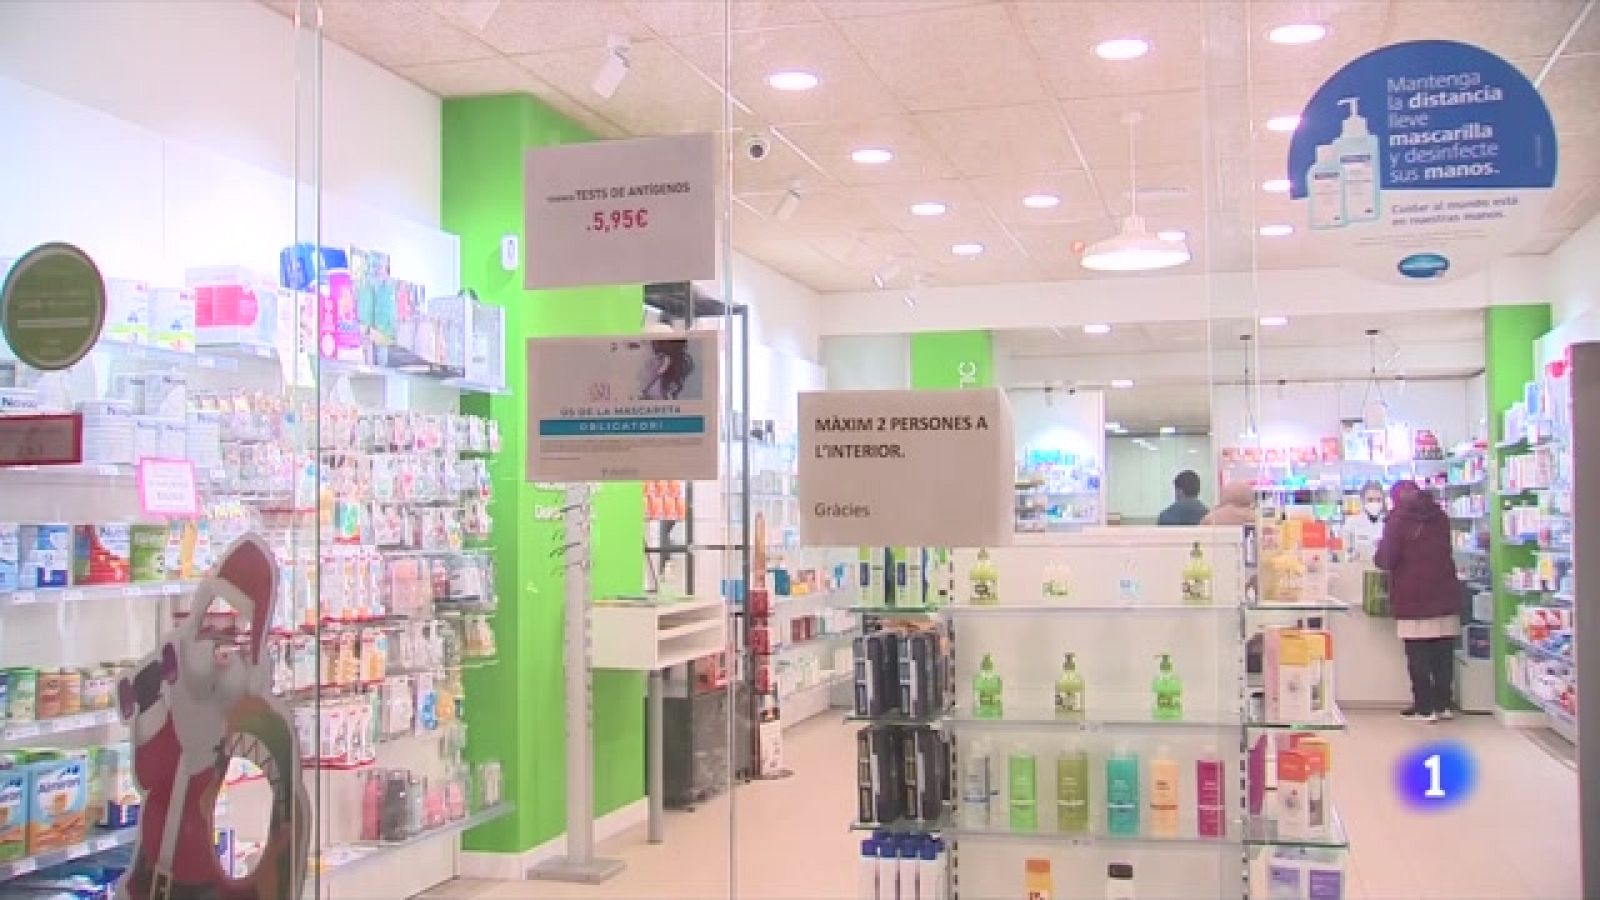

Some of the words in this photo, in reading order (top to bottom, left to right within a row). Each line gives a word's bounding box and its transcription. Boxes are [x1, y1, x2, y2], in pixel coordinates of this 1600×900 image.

[1387, 73, 1480, 91] Mantenga
[1388, 94, 1403, 111] la
[1409, 85, 1503, 109] distancia
[1388, 111, 1428, 128] lleve
[1390, 122, 1493, 146] mascarilla
[1390, 151, 1400, 168] y
[1405, 142, 1499, 163] desinfecte
[1390, 169, 1418, 182] sus
[1424, 162, 1501, 180] manos.
[576, 189, 608, 201] TESTS
[611, 188, 625, 198] DE
[628, 182, 690, 196] ANTÍGENOS
[594, 208, 648, 232] 5,95€
[815, 415, 873, 431] MÀXIM
[877, 417, 886, 431] 2
[891, 415, 971, 430] PERSONES
[975, 415, 988, 430] A
[814, 502, 870, 517] Gràcies
